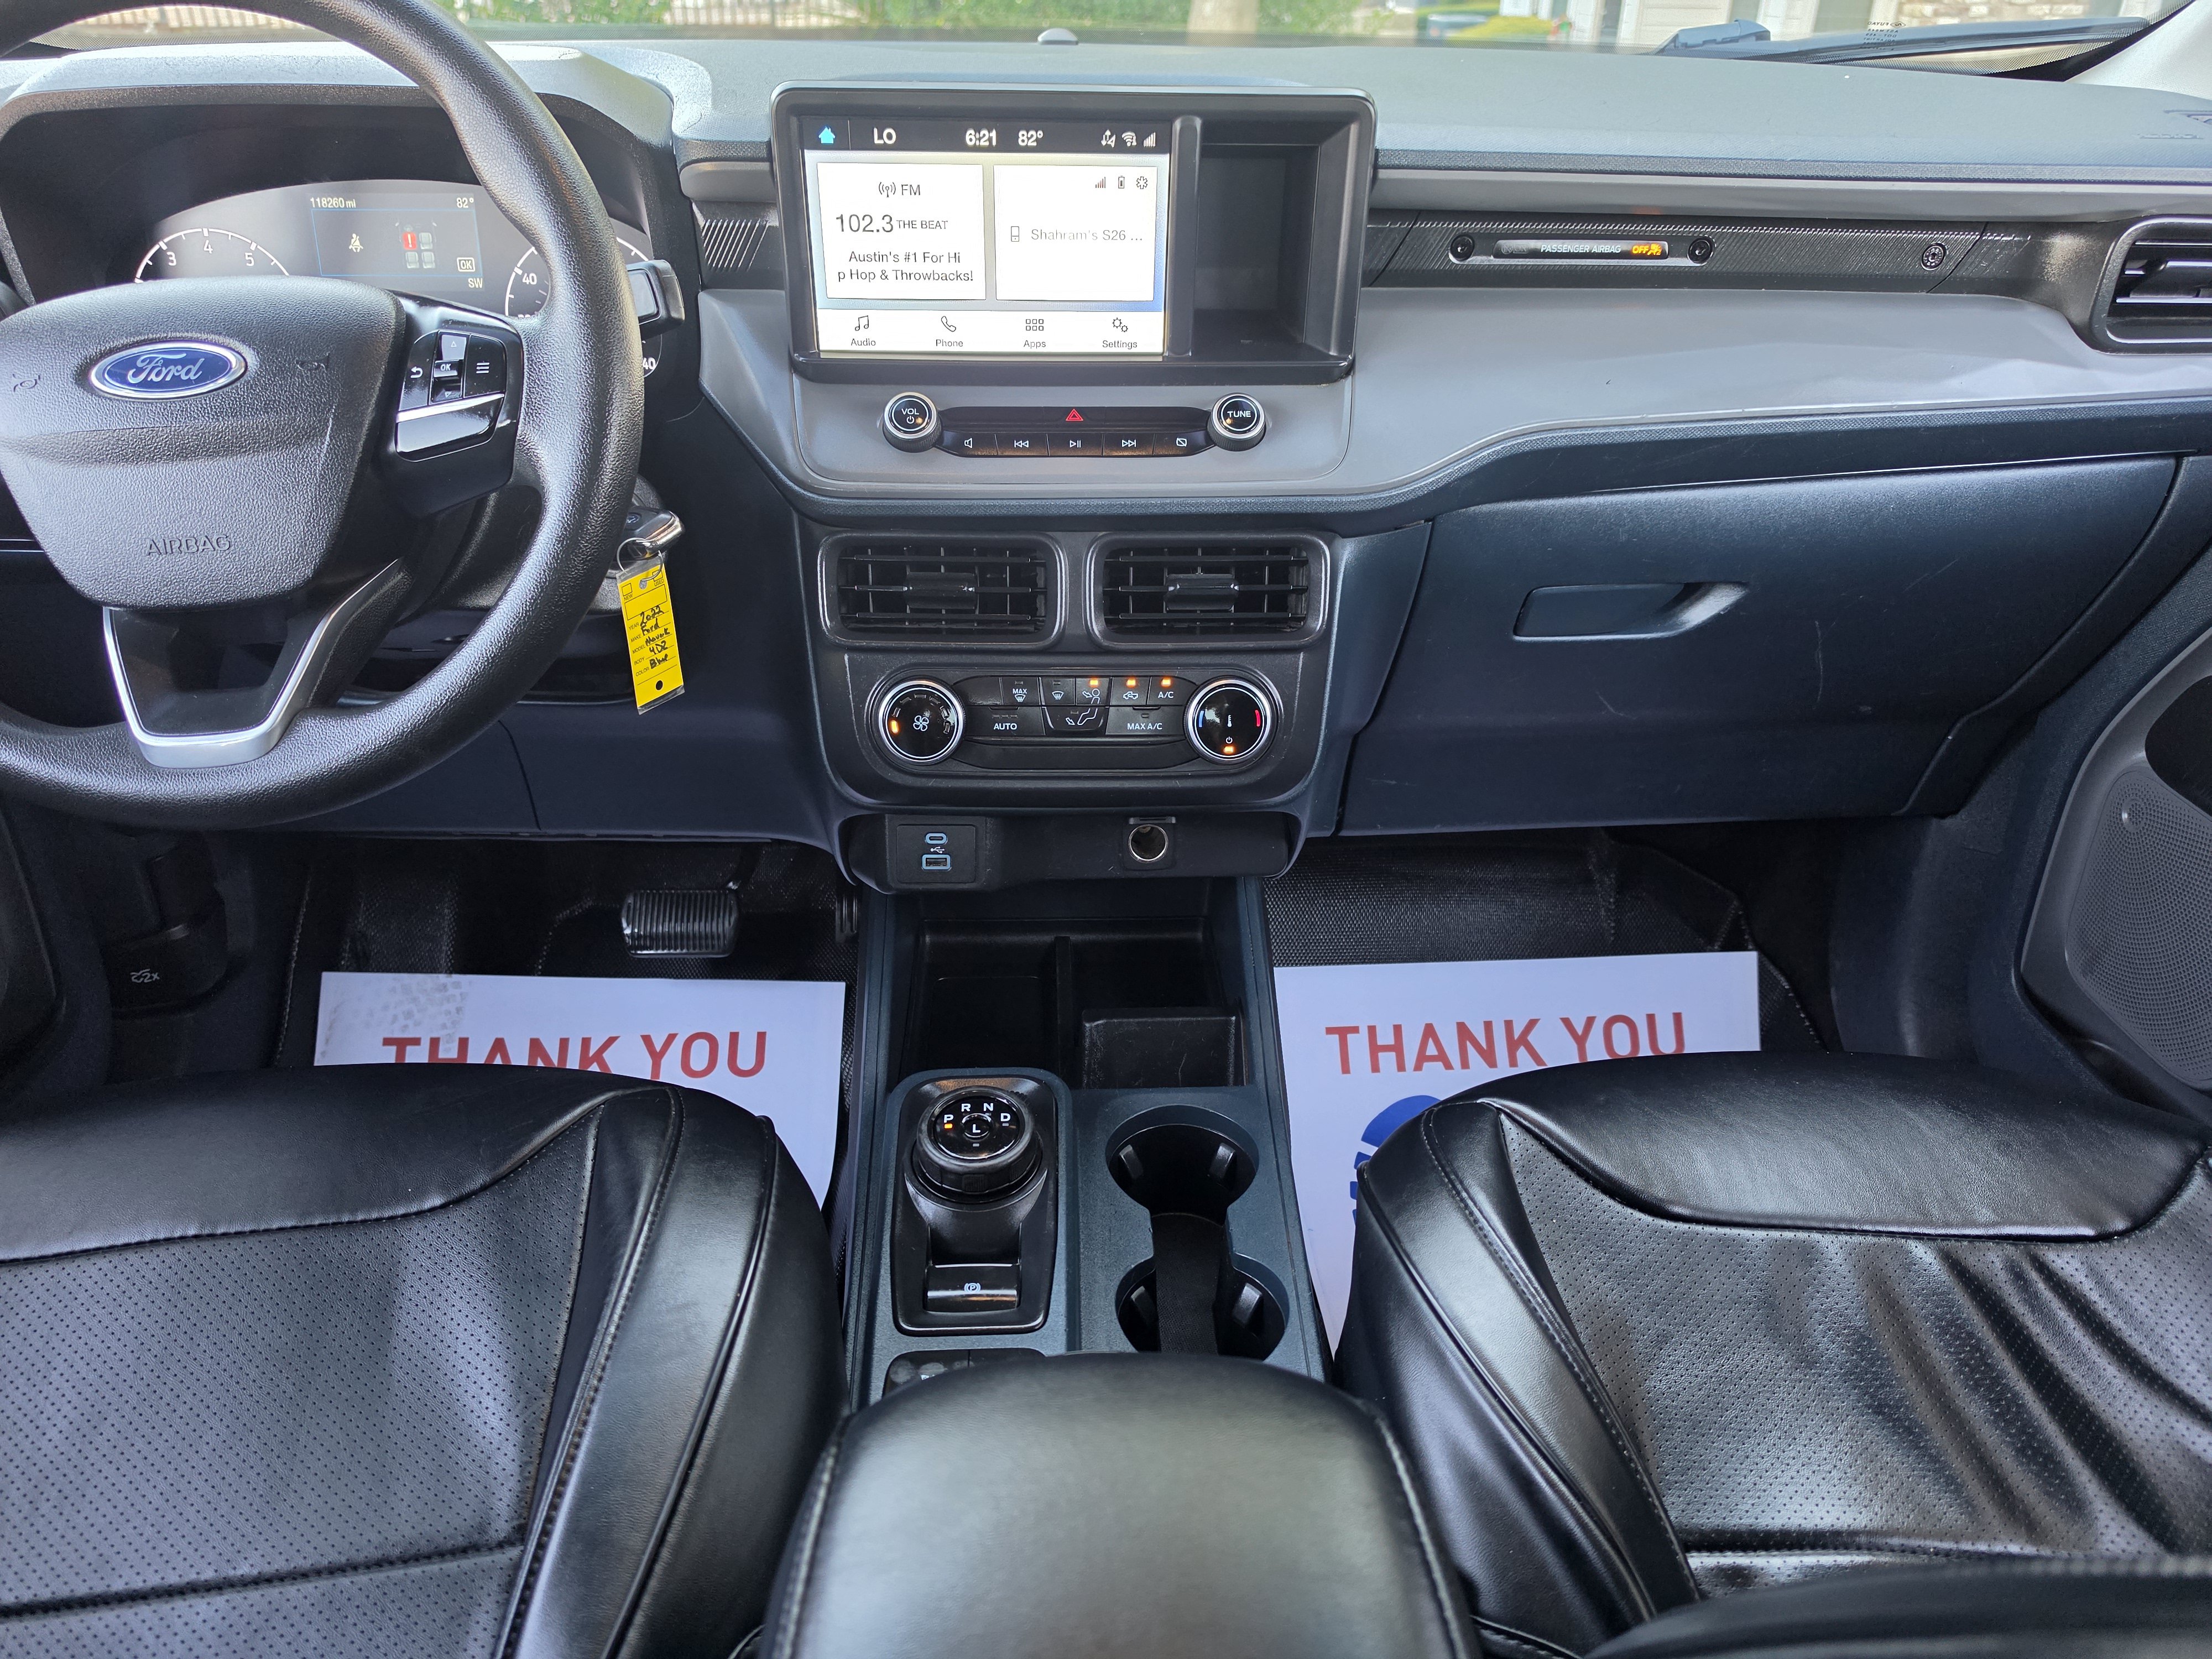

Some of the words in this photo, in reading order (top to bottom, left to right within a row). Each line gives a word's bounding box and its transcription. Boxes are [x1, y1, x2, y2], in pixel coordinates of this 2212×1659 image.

[873, 127, 896, 144] LO
[966, 128, 997, 147] 6:21
[1018, 129, 1044, 146] 82°
[901, 184, 921, 196] FM
[310, 197, 345, 208] 118260
[456, 197, 474, 208] 82°
[836, 213, 894, 233] 102.3
[896, 220, 917, 229] THE
[920, 220, 948, 229] BEAT
[1031, 228, 1098, 241] Shahram's
[1102, 229, 1126, 241] S26
[204, 239, 213, 254] 4
[1540, 244, 1590, 253] PASSENGER
[1591, 245, 1621, 253] AIRBAG
[1632, 245, 1649, 254] OFF
[166, 252, 177, 266] 3
[244, 252, 254, 267] 5
[848, 251, 900, 263] Austin's
[904, 252, 917, 263] #1
[923, 252, 944, 263] For
[948, 252, 961, 263] Hi
[460, 260, 473, 270] OK
[521, 273, 538, 285] 40
[837, 270, 846, 282] p
[849, 269, 876, 283] Hop
[880, 269, 889, 280] &
[891, 269, 974, 281] Throwbacks!
[468, 278, 483, 289] SW
[851, 338, 876, 347] Audio
[936, 339, 964, 347] Phone
[1023, 340, 1046, 349] Apps
[1102, 340, 1138, 350] Settings
[127, 353, 205, 384] Ford
[440, 363, 452, 372] OK
[147, 534, 231, 556] AIRBAG
[654, 578, 665, 587] USED
[624, 593, 633, 602] NEW
[629, 622, 640, 630] YEAR
[630, 633, 642, 643] MAKE
[632, 644, 646, 654] MODEL
[634, 657, 645, 666] BODY
[635, 666, 650, 677] COLOR
[1325, 1018, 1547, 1074] THANK
[1560, 1011, 1686, 1063] YOU
[640, 1031, 768, 1081] YOU
[961, 1103, 971, 1112] R
[983, 1103, 994, 1112] N
[943, 1114, 954, 1123] P
[1000, 1113, 1011, 1122] D
[972, 1124, 981, 1133] L
